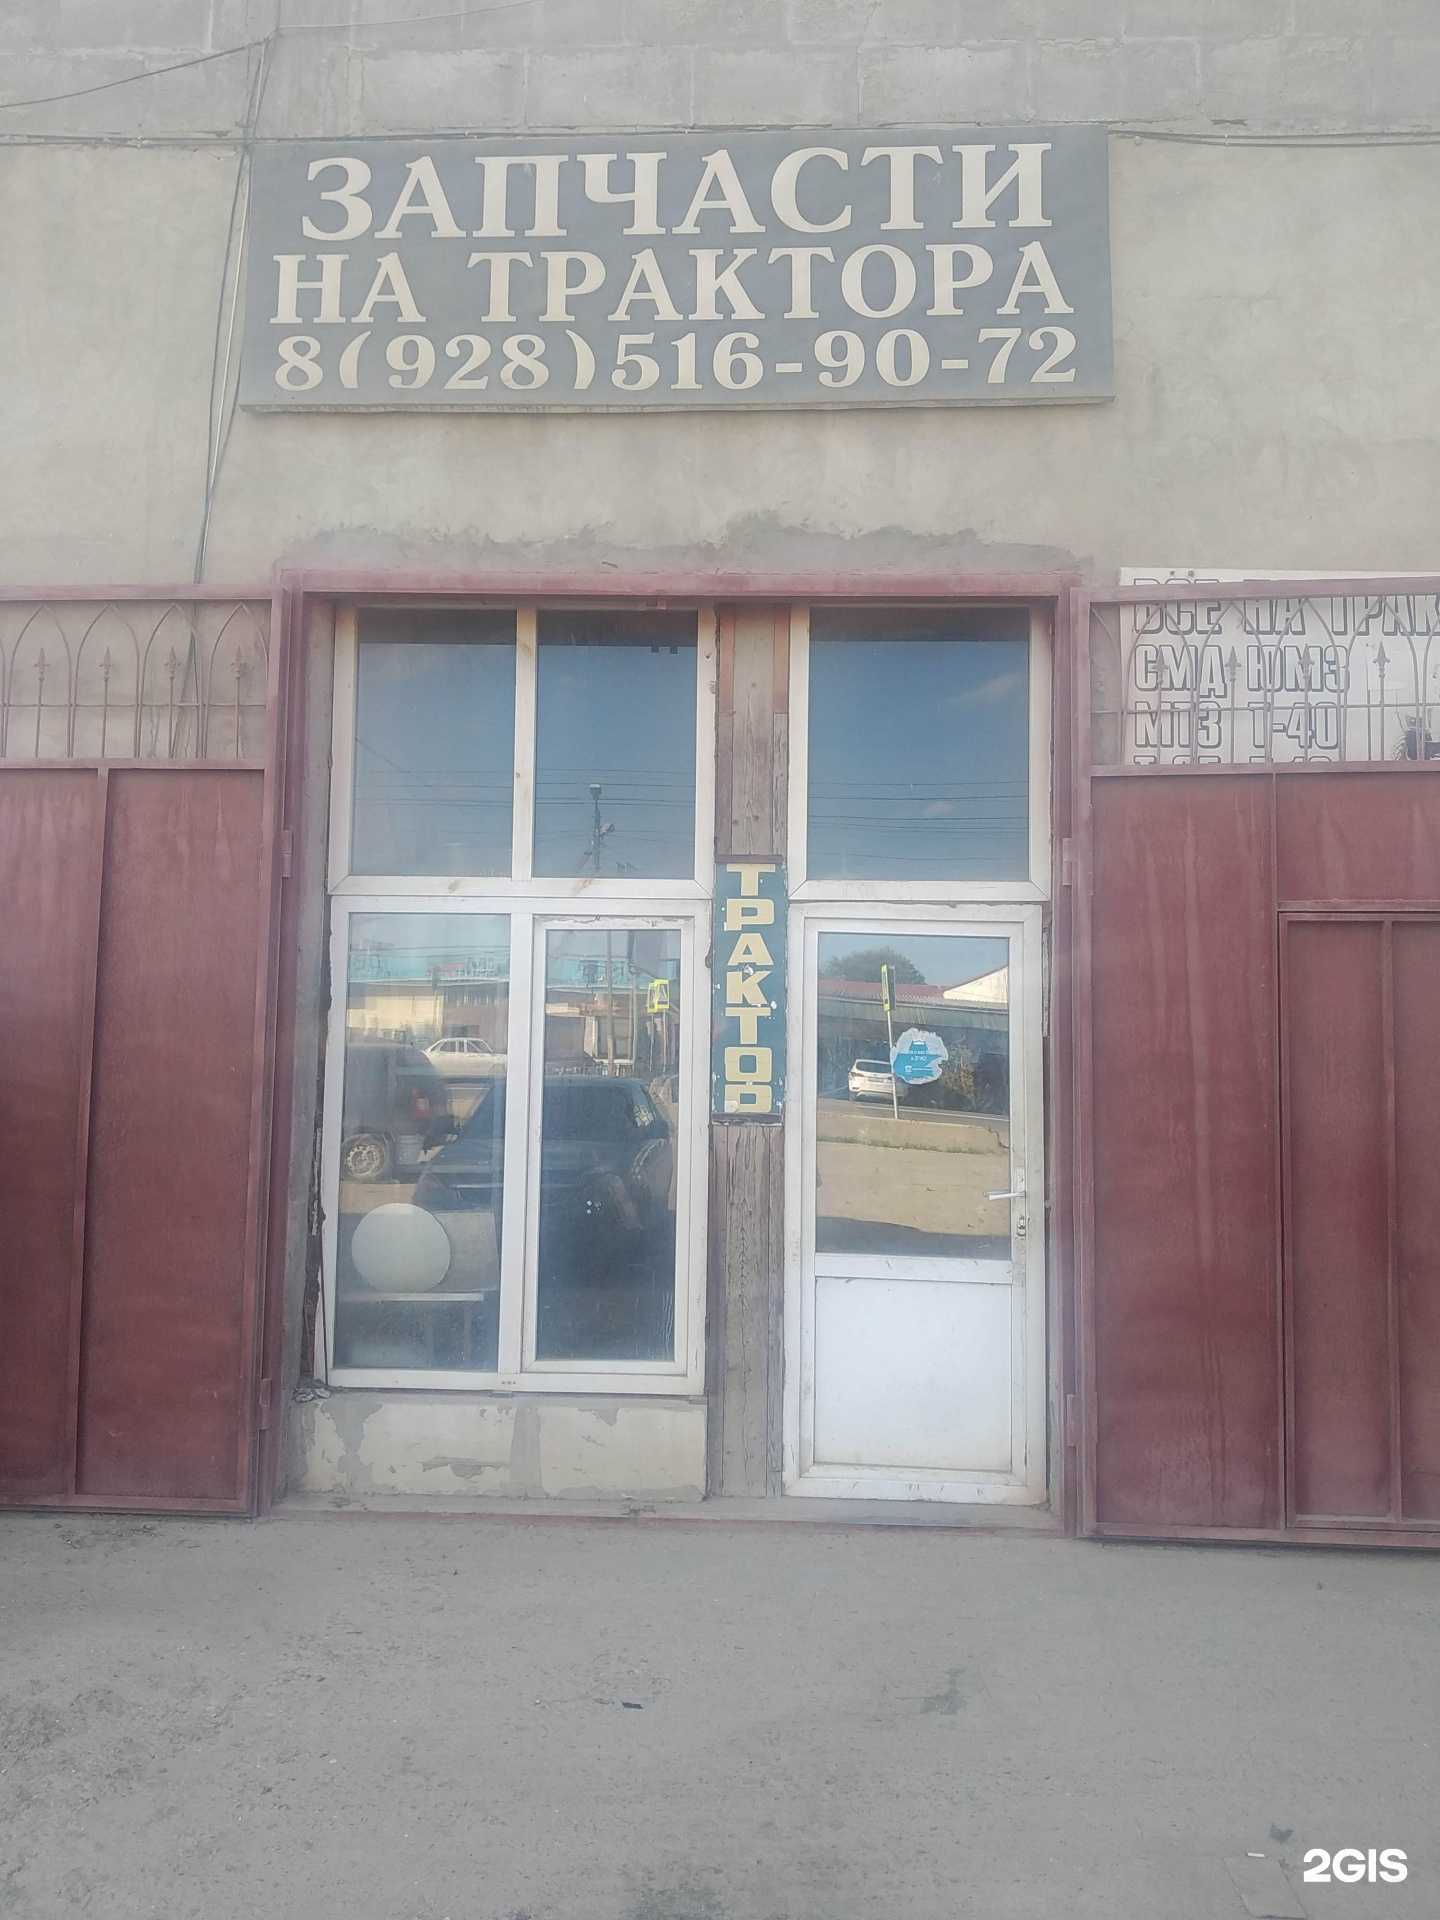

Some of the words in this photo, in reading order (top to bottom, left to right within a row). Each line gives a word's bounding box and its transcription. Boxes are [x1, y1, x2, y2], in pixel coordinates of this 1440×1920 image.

[302, 143, 1053, 241] ЗАПЧАСТИ
[269, 251, 428, 324] НА
[467, 241, 1075, 323] ТРАКТОРА
[274, 326, 1078, 392] 8(928)516-90-72
[1247, 645, 1350, 692] ЮМЗ
[1134, 701, 1222, 748] МТЗ
[1248, 702, 1339, 750] Т-40
